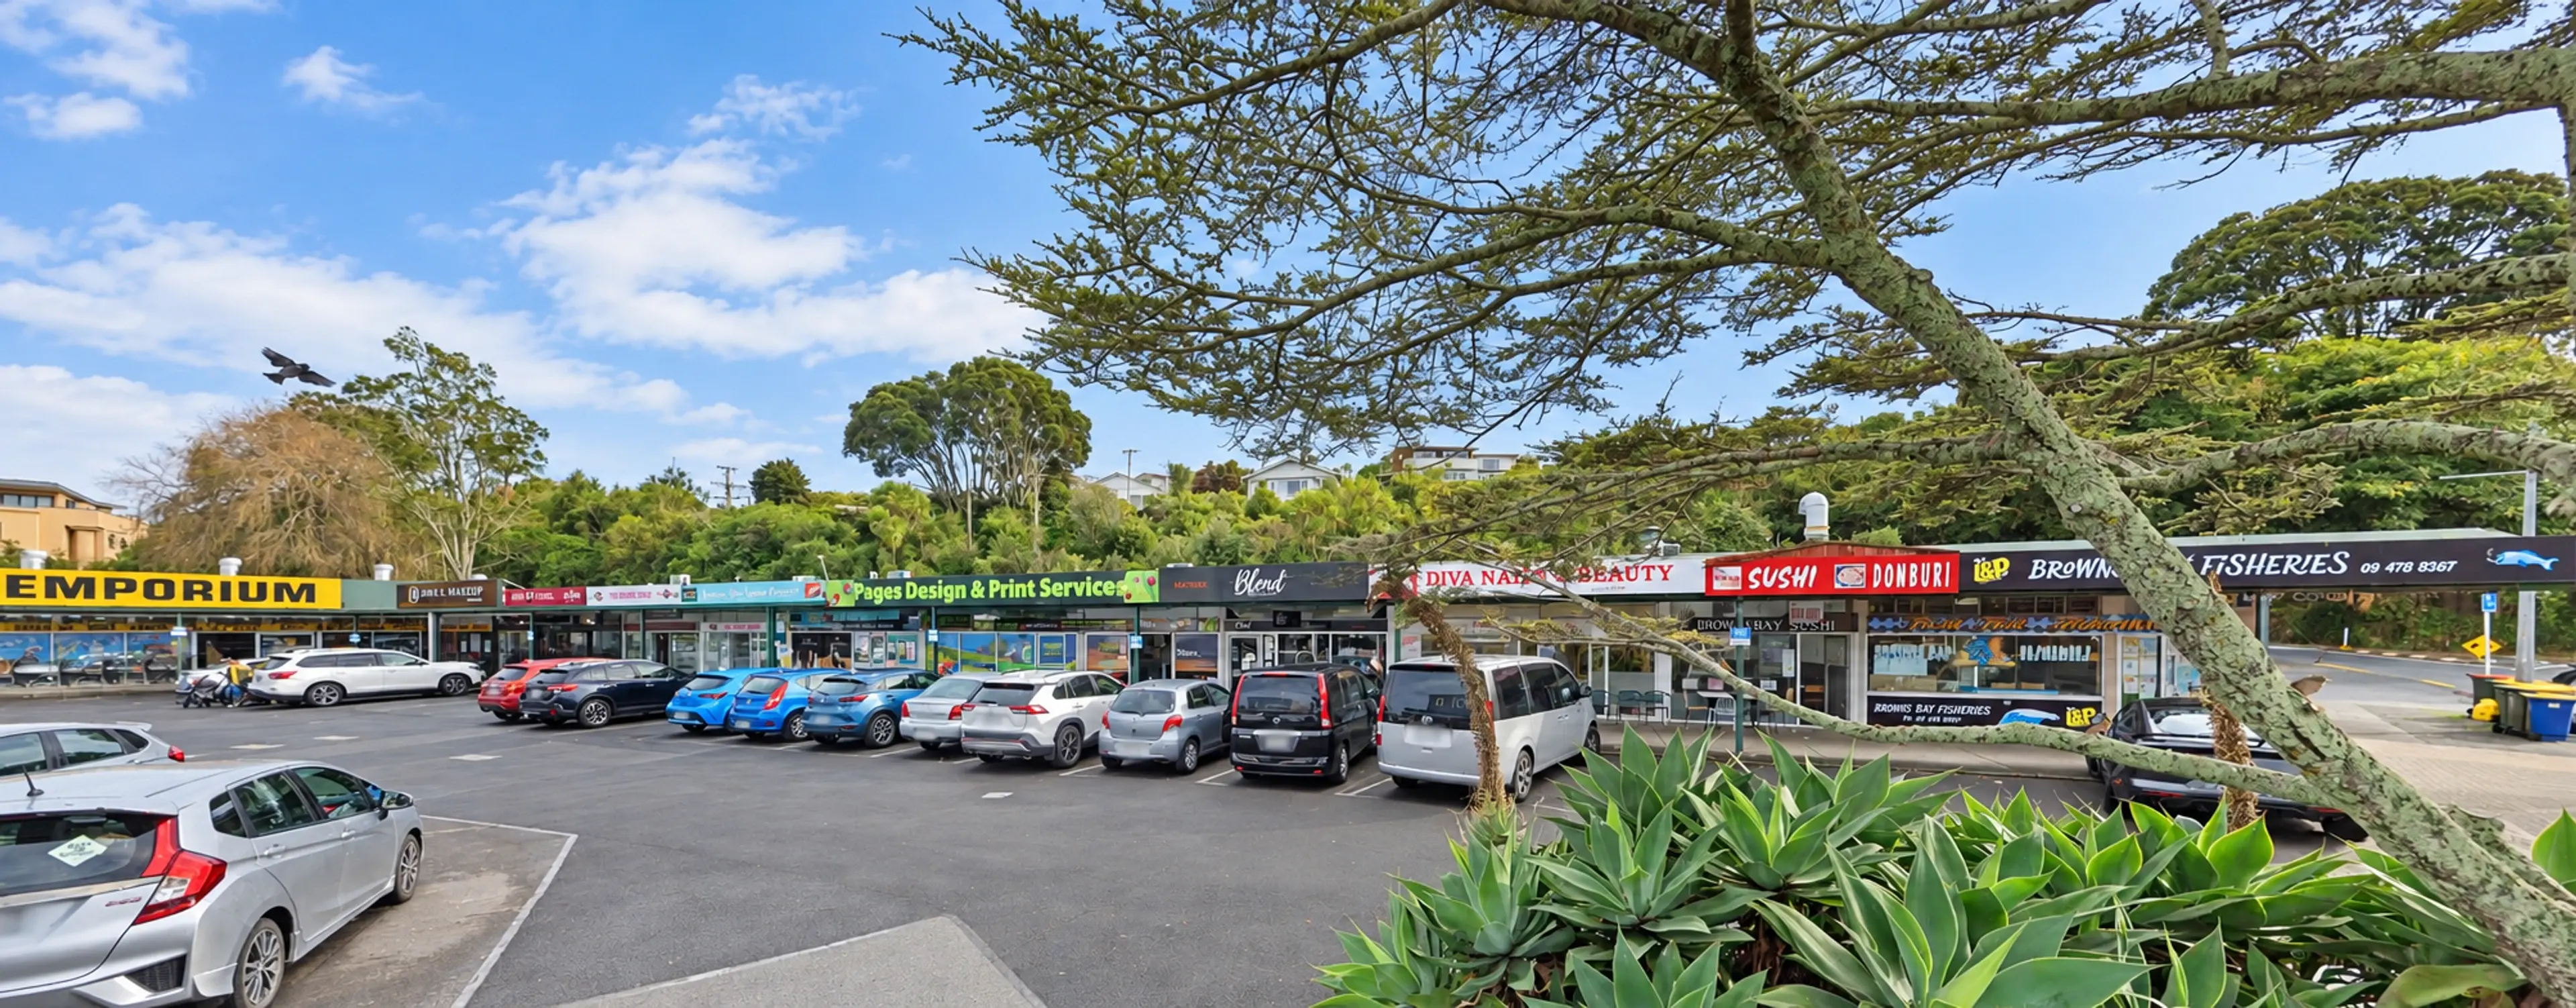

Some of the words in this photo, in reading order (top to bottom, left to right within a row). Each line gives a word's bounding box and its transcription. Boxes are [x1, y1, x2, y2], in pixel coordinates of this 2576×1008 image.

[1426, 570, 1474, 586] DIVA
[1577, 564, 1674, 583] BEAUTY
[1748, 564, 1817, 589] SUSHI
[1873, 561, 1950, 588] DONBURI
[1974, 557, 2010, 583] L&P
[2027, 557, 2118, 579] BROWN
[2360, 562, 2380, 573] 09
[2385, 561, 2414, 573] 478
[2418, 560, 2457, 572] 8367
[5, 574, 316, 603] EMPORIUM
[854, 583, 902, 605] Pages
[906, 579, 967, 604] Design
[970, 580, 985, 599] &
[989, 578, 1036, 599] Print
[1040, 576, 1126, 598] Services
[1234, 568, 1287, 596] Blend
[1697, 619, 1751, 631] BROW
[1915, 704, 1936, 714] BAY
[1937, 705, 1992, 716] FISHERIES
[2065, 707, 2096, 727] L&P
